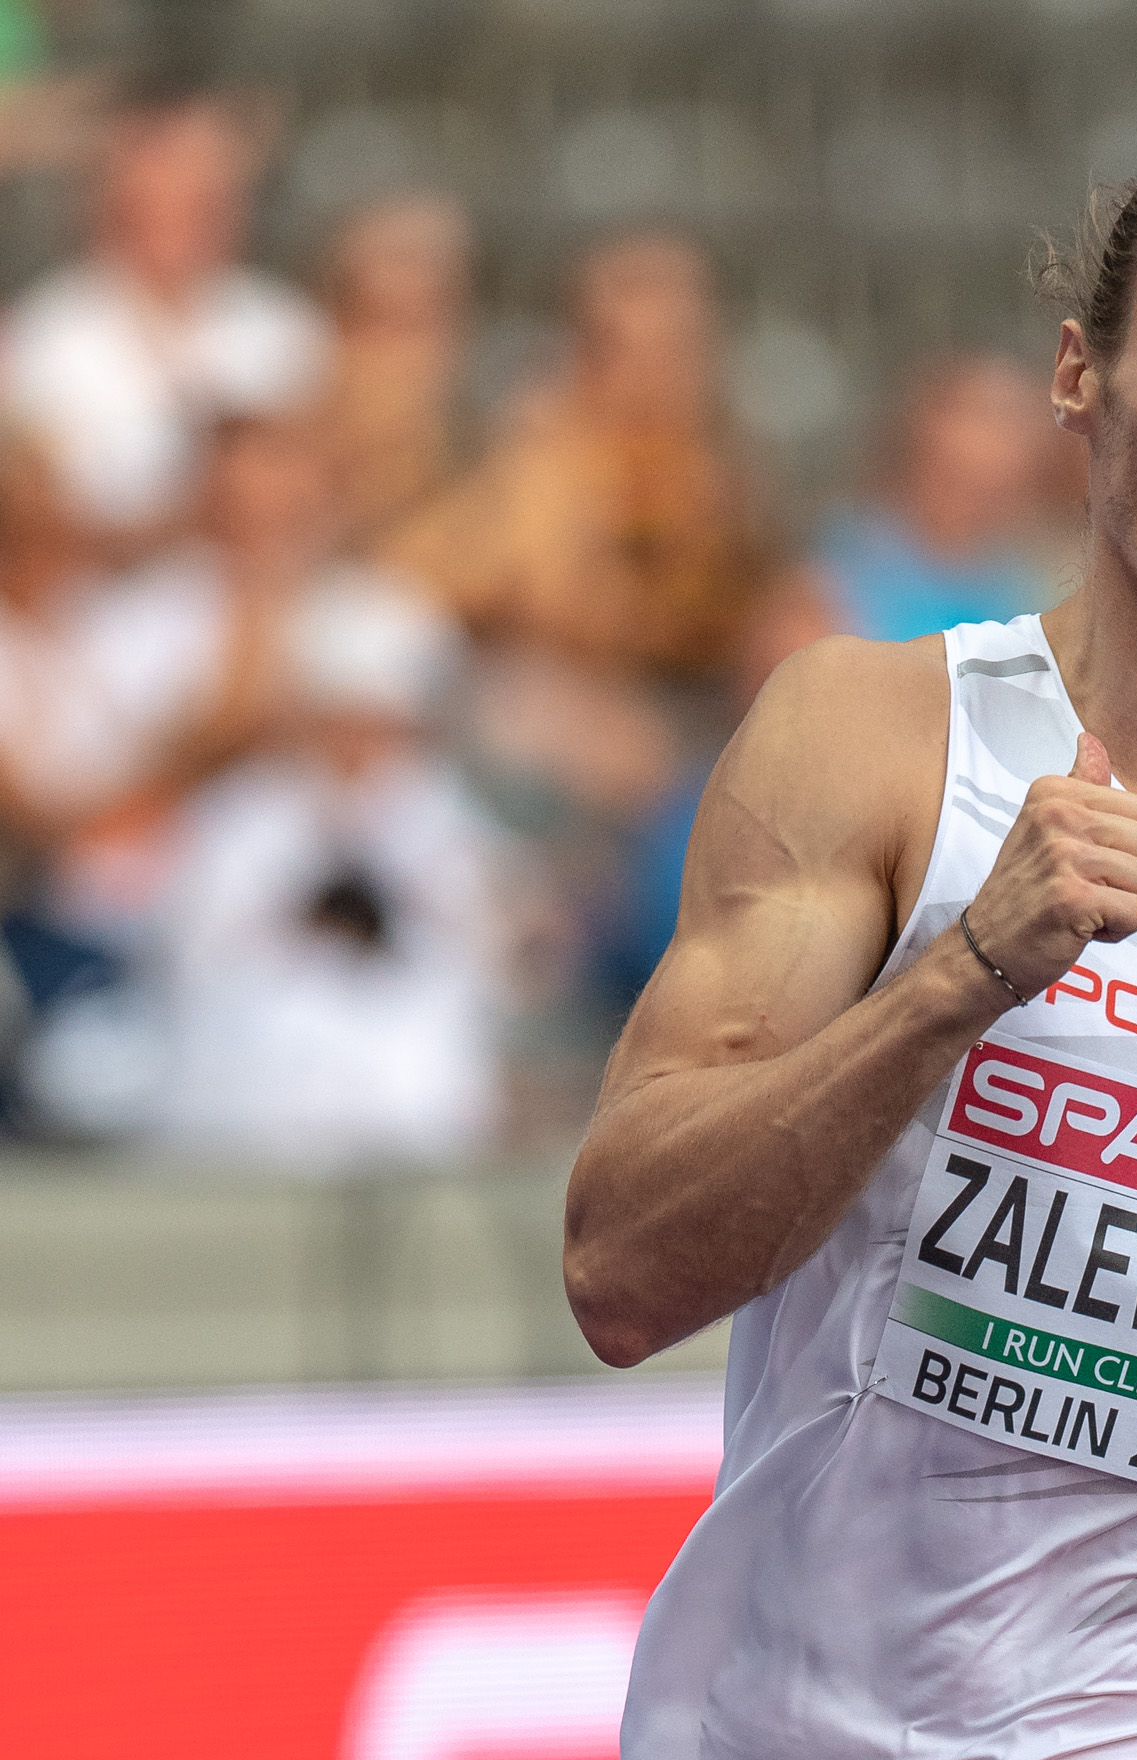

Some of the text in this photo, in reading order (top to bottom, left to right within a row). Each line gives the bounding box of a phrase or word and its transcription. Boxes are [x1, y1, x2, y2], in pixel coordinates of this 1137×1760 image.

[981, 1321, 995, 1350] I
[1002, 1328, 1085, 1377] RUN
[912, 1349, 1119, 1458] BERLIN
